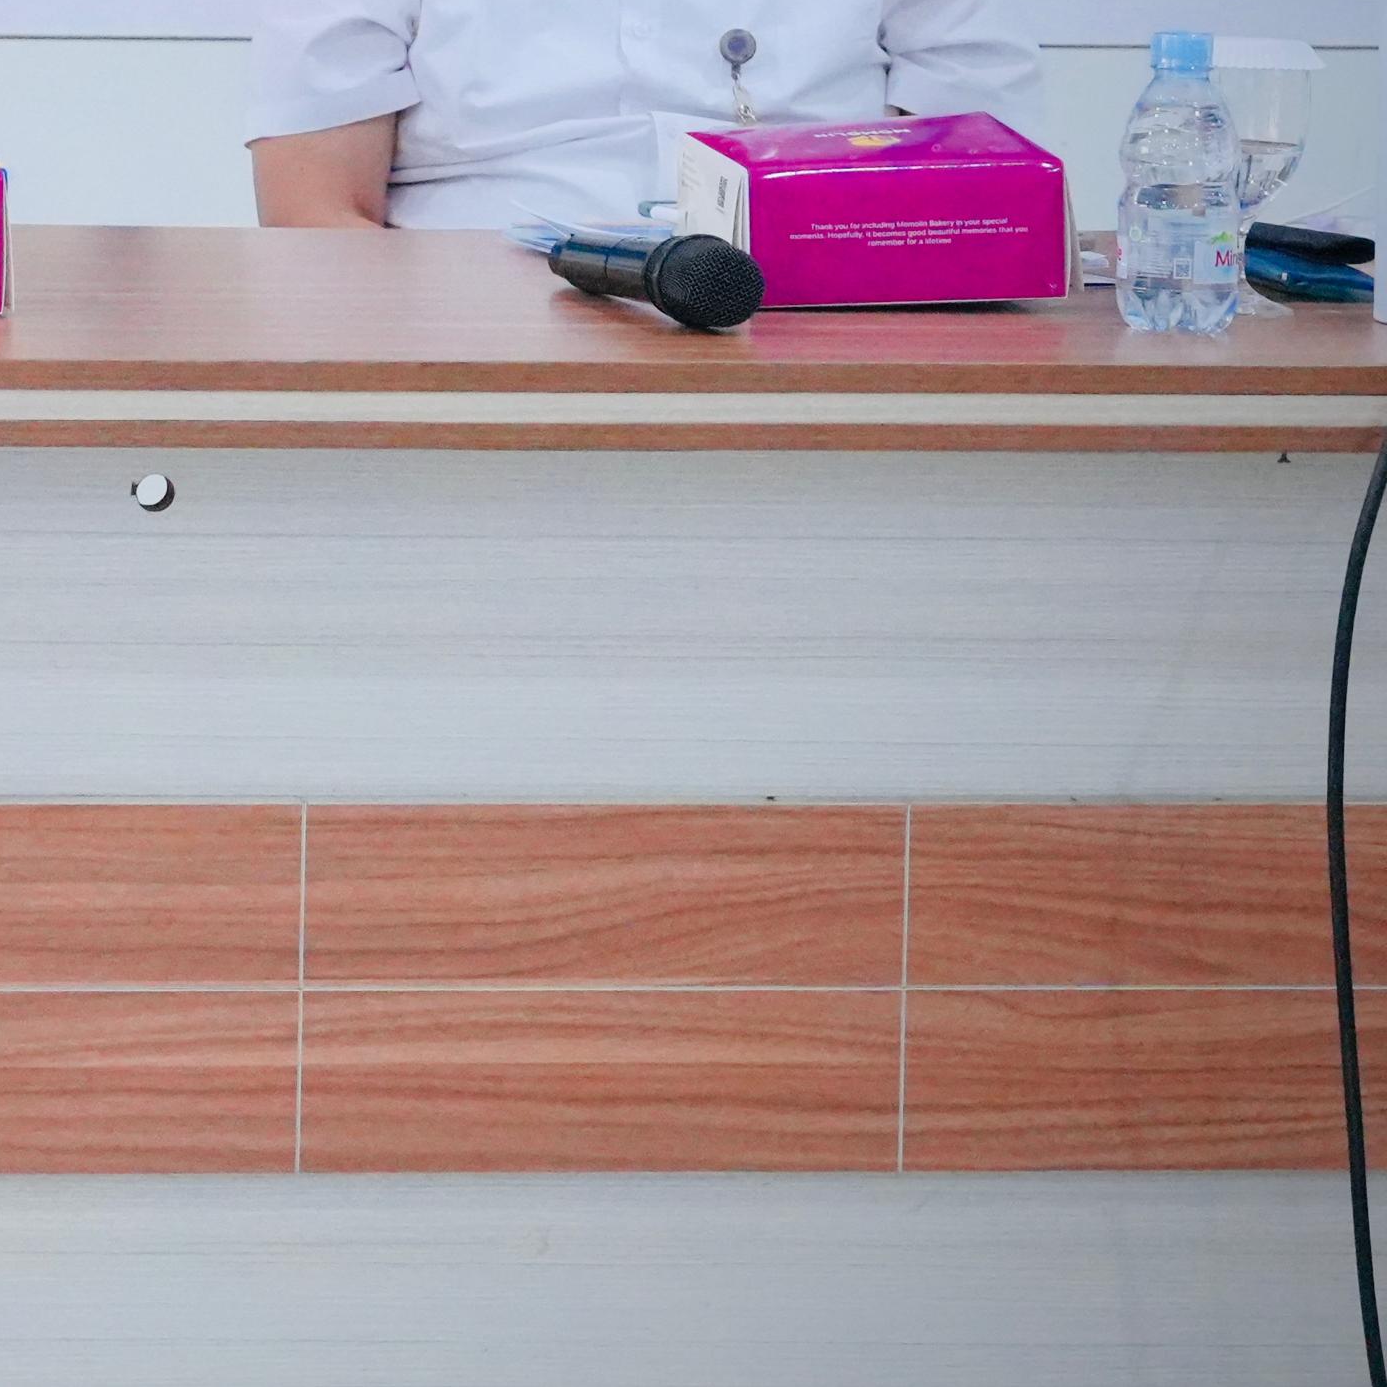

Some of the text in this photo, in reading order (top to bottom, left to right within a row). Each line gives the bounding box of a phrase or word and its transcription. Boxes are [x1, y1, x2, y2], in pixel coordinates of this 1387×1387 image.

[810, 223, 834, 231] Thank
[861, 222, 896, 230] including
[929, 219, 955, 227] Bakery
[963, 219, 981, 227] your
[982, 217, 1009, 225] special
[907, 229, 927, 237] good
